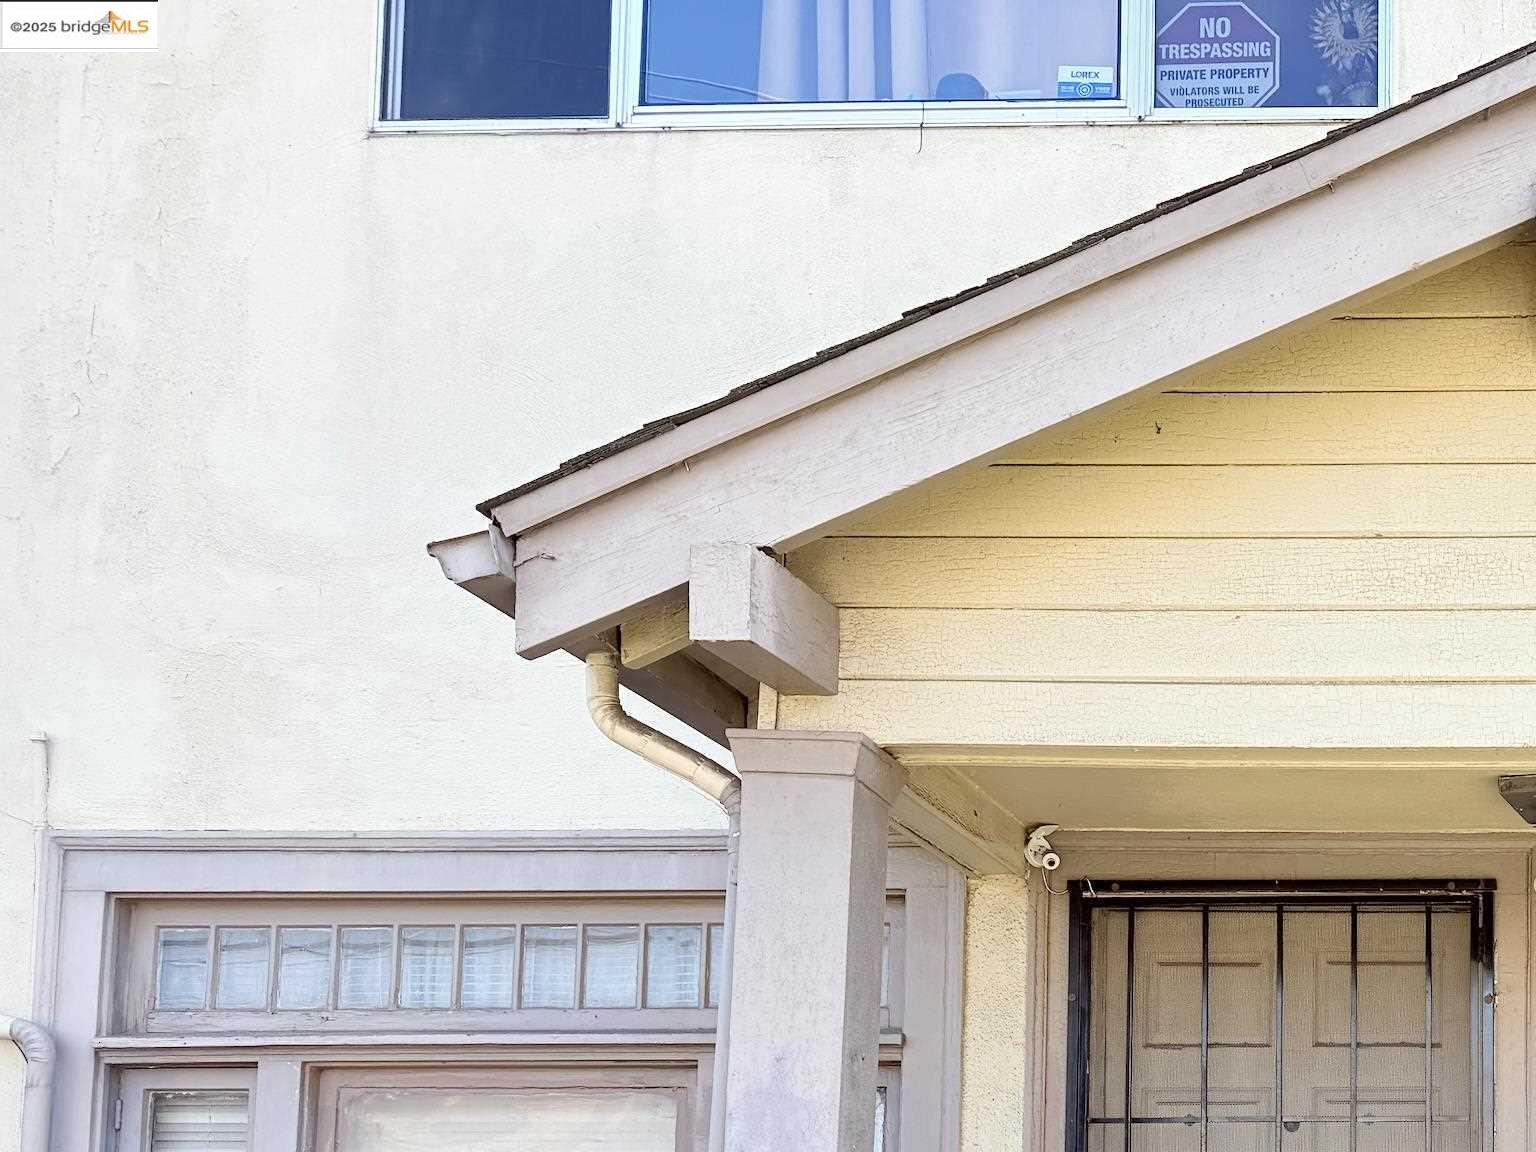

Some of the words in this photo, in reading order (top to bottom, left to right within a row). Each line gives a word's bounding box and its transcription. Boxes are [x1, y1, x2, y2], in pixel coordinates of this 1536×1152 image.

[1199, 16, 1232, 39] NO
[1159, 41, 1272, 60] TRESPASSING
[1071, 70, 1100, 79] LOREX
[1160, 69, 1207, 81] PRIVATE
[1210, 67, 1270, 80] PROPERTY
[1170, 86, 1220, 97] VIOLATORS
[1223, 86, 1245, 95] WILL
[1248, 85, 1260, 94] BE
[1185, 97, 1244, 107] PROSECUTED
